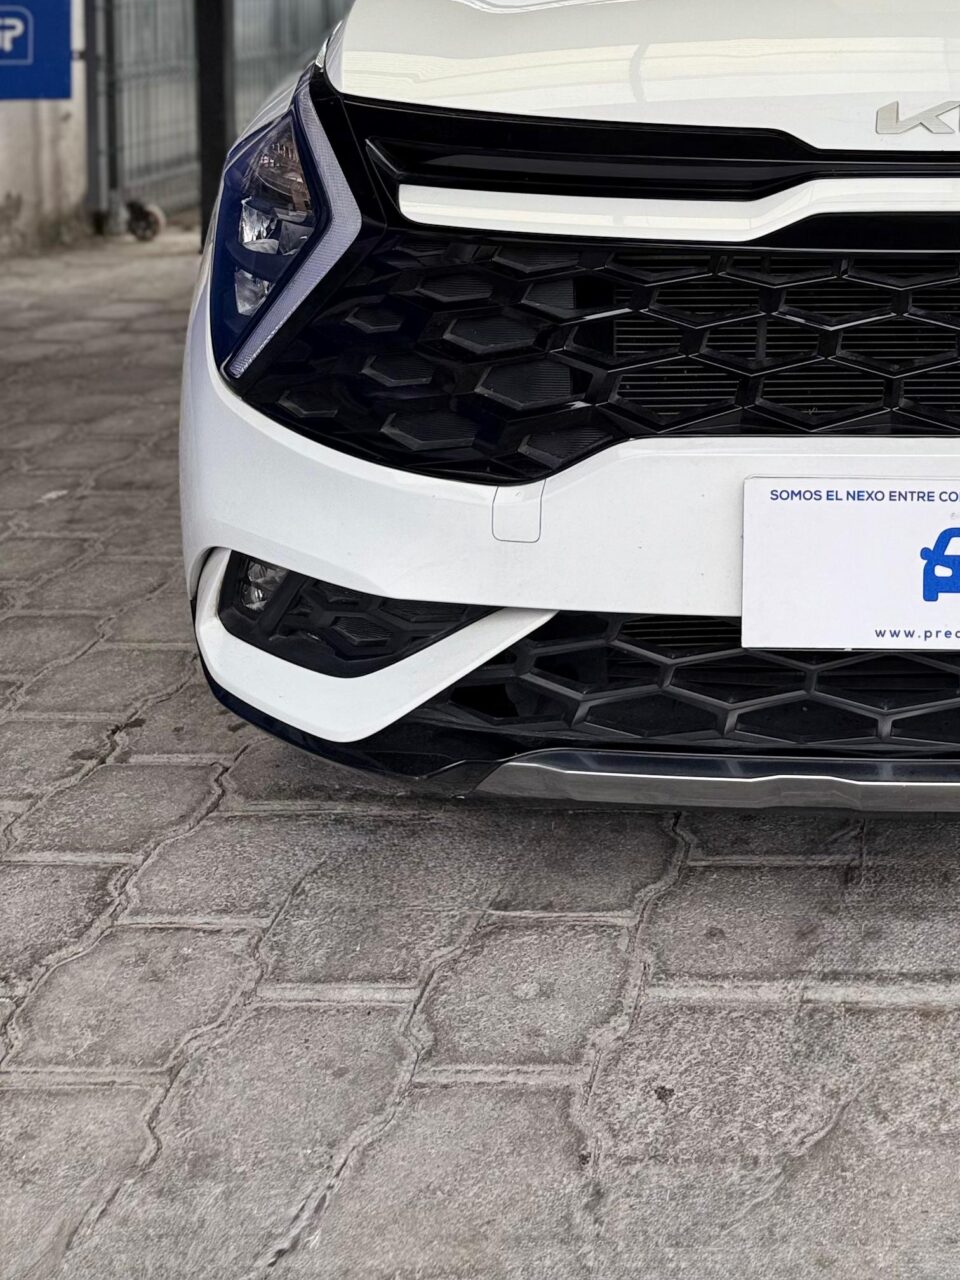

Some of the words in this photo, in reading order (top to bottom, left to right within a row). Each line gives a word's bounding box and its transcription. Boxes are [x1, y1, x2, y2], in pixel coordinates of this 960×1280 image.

[769, 489, 823, 502] SOMOS
[825, 490, 843, 502] EL
[846, 490, 885, 502] NEXO
[888, 491, 936, 503] ENTRE
